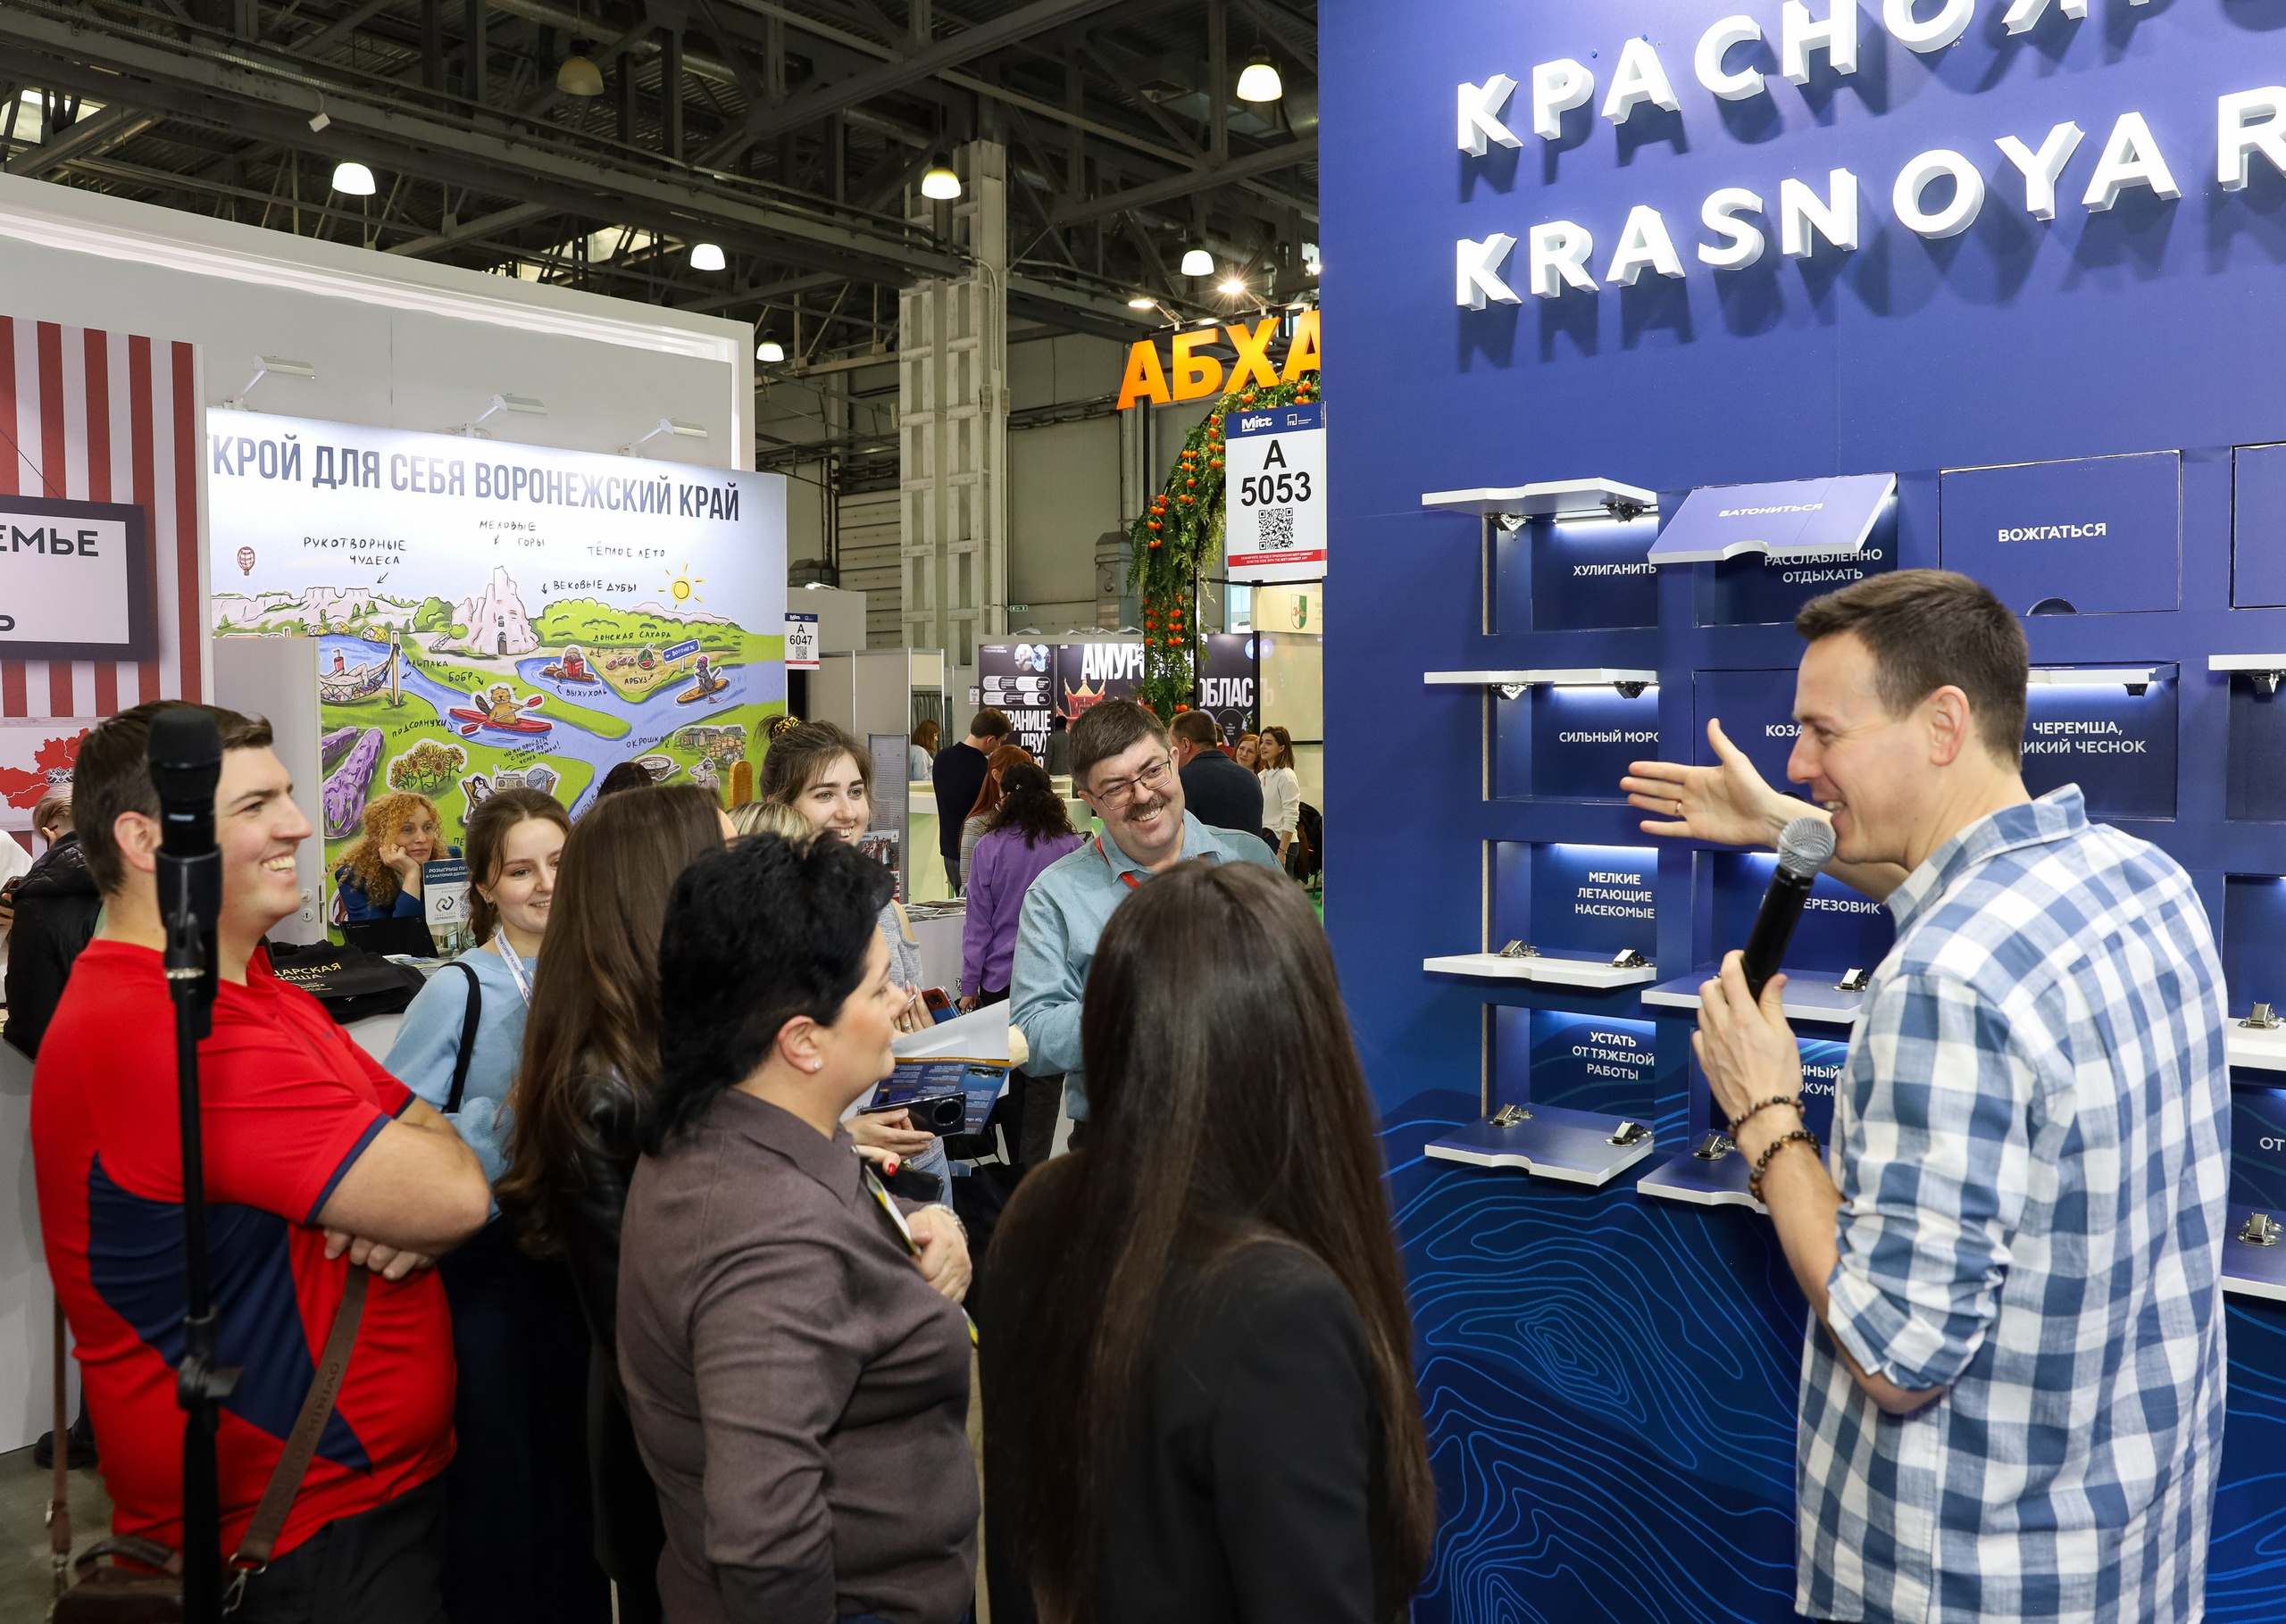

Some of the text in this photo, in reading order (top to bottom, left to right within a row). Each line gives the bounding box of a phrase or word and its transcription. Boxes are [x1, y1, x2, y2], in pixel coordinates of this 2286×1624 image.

[1457, 0, 2148, 157] КРАСНО
[1456, 85, 2286, 311] KRASNOYAR
[1116, 309, 1320, 411] АБХА
[1263, 439, 1287, 471] A
[207, 434, 739, 521] КРОЙ ДЛЯ СЕБЯ ВОРОНЕЖСКИЙ КРАЙ
[1240, 471, 1311, 506] 5053
[1718, 502, 1823, 518] БАТОНИТЬСЯ
[480, 520, 536, 531] МЕЛОВЫЕ
[1998, 522, 2107, 543] ВОЖГАТЬСЯ
[304, 537, 407, 551] РУКОТВОРНЫЕ
[518, 537, 545, 547] ГОРЫ
[349, 554, 400, 566] ЧУДЕСА
[638, 548, 665, 559] ЛЕТО
[1764, 548, 1883, 566] РАССЛАБЛЕННО
[1573, 563, 1657, 577] ХУЛИГАНИТЬ
[1782, 568, 1864, 584] ОТДЫХАТЬ
[554, 579, 637, 593] ВЕКОВЫЕ ДУБЫ
[593, 630, 671, 642] ДОНСКАЯ САХАРА
[797, 624, 805, 634] A
[789, 635, 813, 645] 6047
[405, 659, 448, 669] АЛЬПАКА
[448, 671, 473, 683] БОБР
[624, 676, 648, 686] АРБУЗ
[566, 687, 607, 697] ВЫХУХОЛЬ
[392, 720, 446, 738] ПОДСОЛНУХИ
[2032, 720, 2123, 737] ЧЕРЕМША,
[626, 736, 665, 750] ОКРОШКА
[1558, 729, 1622, 743] СИЛЬНЫЙ
[2075, 740, 2147, 754] ЧЕСНОК
[1589, 871, 1641, 885] МЕЛКИЕ
[1577, 887, 1653, 903] ЛЕТАЮЩИЕ
[1759, 894, 1881, 914] ЕРЕЗОВИК
[1574, 904, 1656, 919] НАСЕКОМЫЕ
[1589, 1031, 1637, 1047] УСТАТЬ
[1572, 1045, 1656, 1066] ОТ ТЯЖЕЛОЙ
[1586, 1063, 1639, 1080] РАБОТЫ
